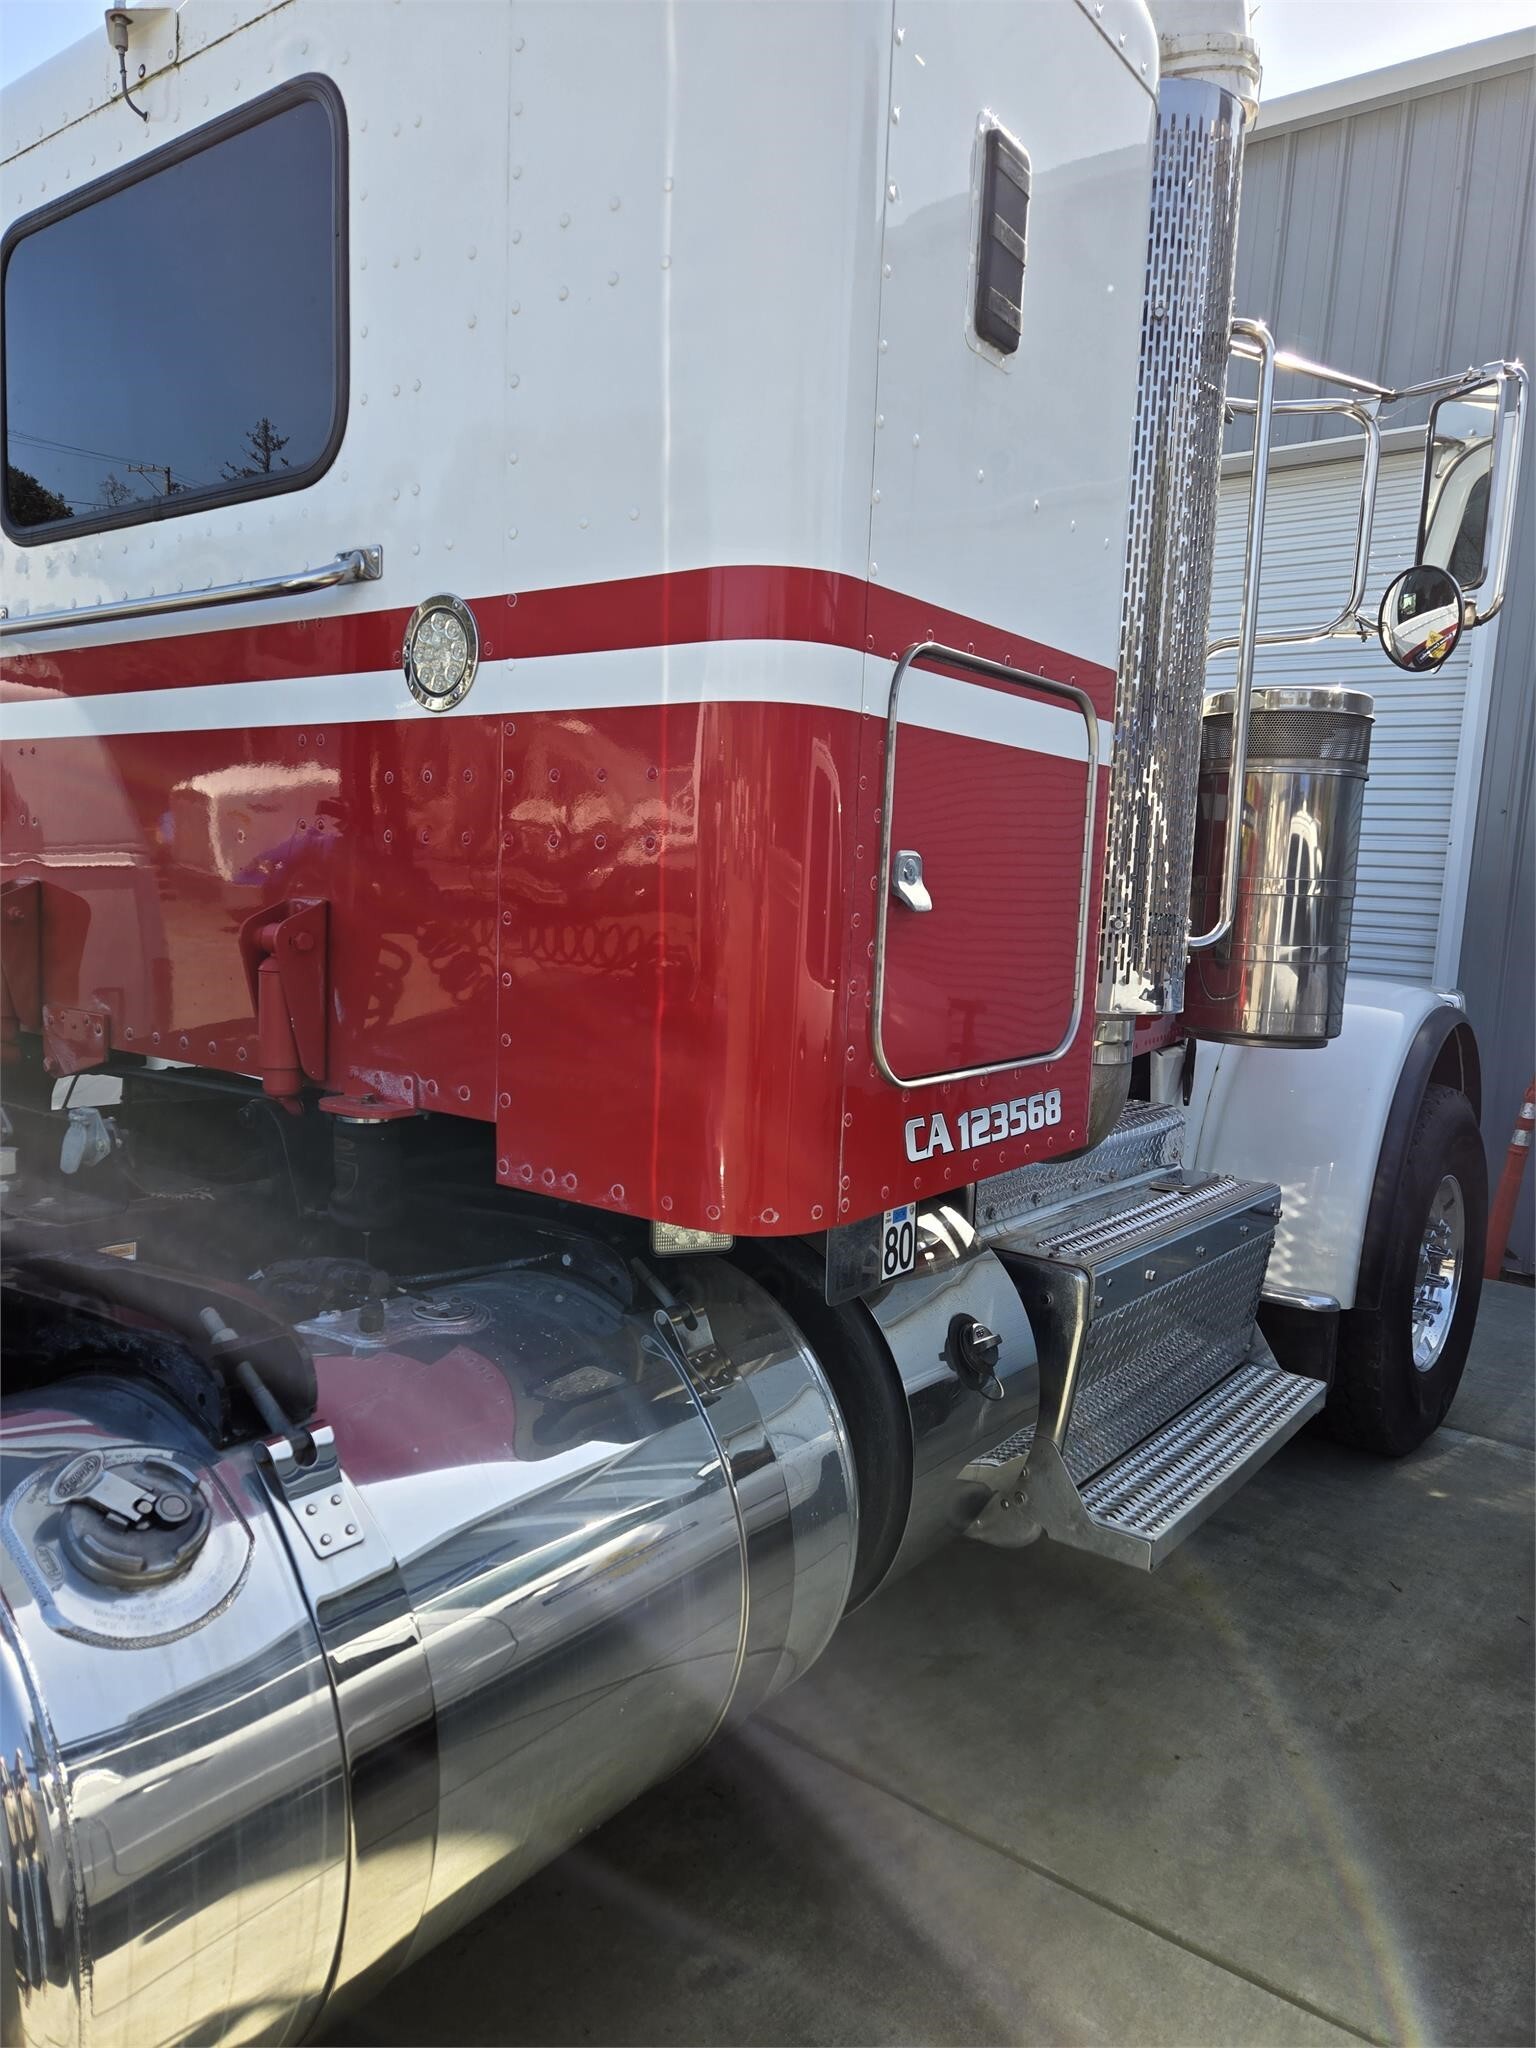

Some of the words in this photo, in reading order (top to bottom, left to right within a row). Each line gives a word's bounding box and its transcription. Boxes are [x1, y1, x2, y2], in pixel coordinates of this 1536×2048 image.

[905, 1113, 955, 1162] CA
[957, 1088, 1062, 1151] 123568
[884, 1221, 914, 1276] 80
